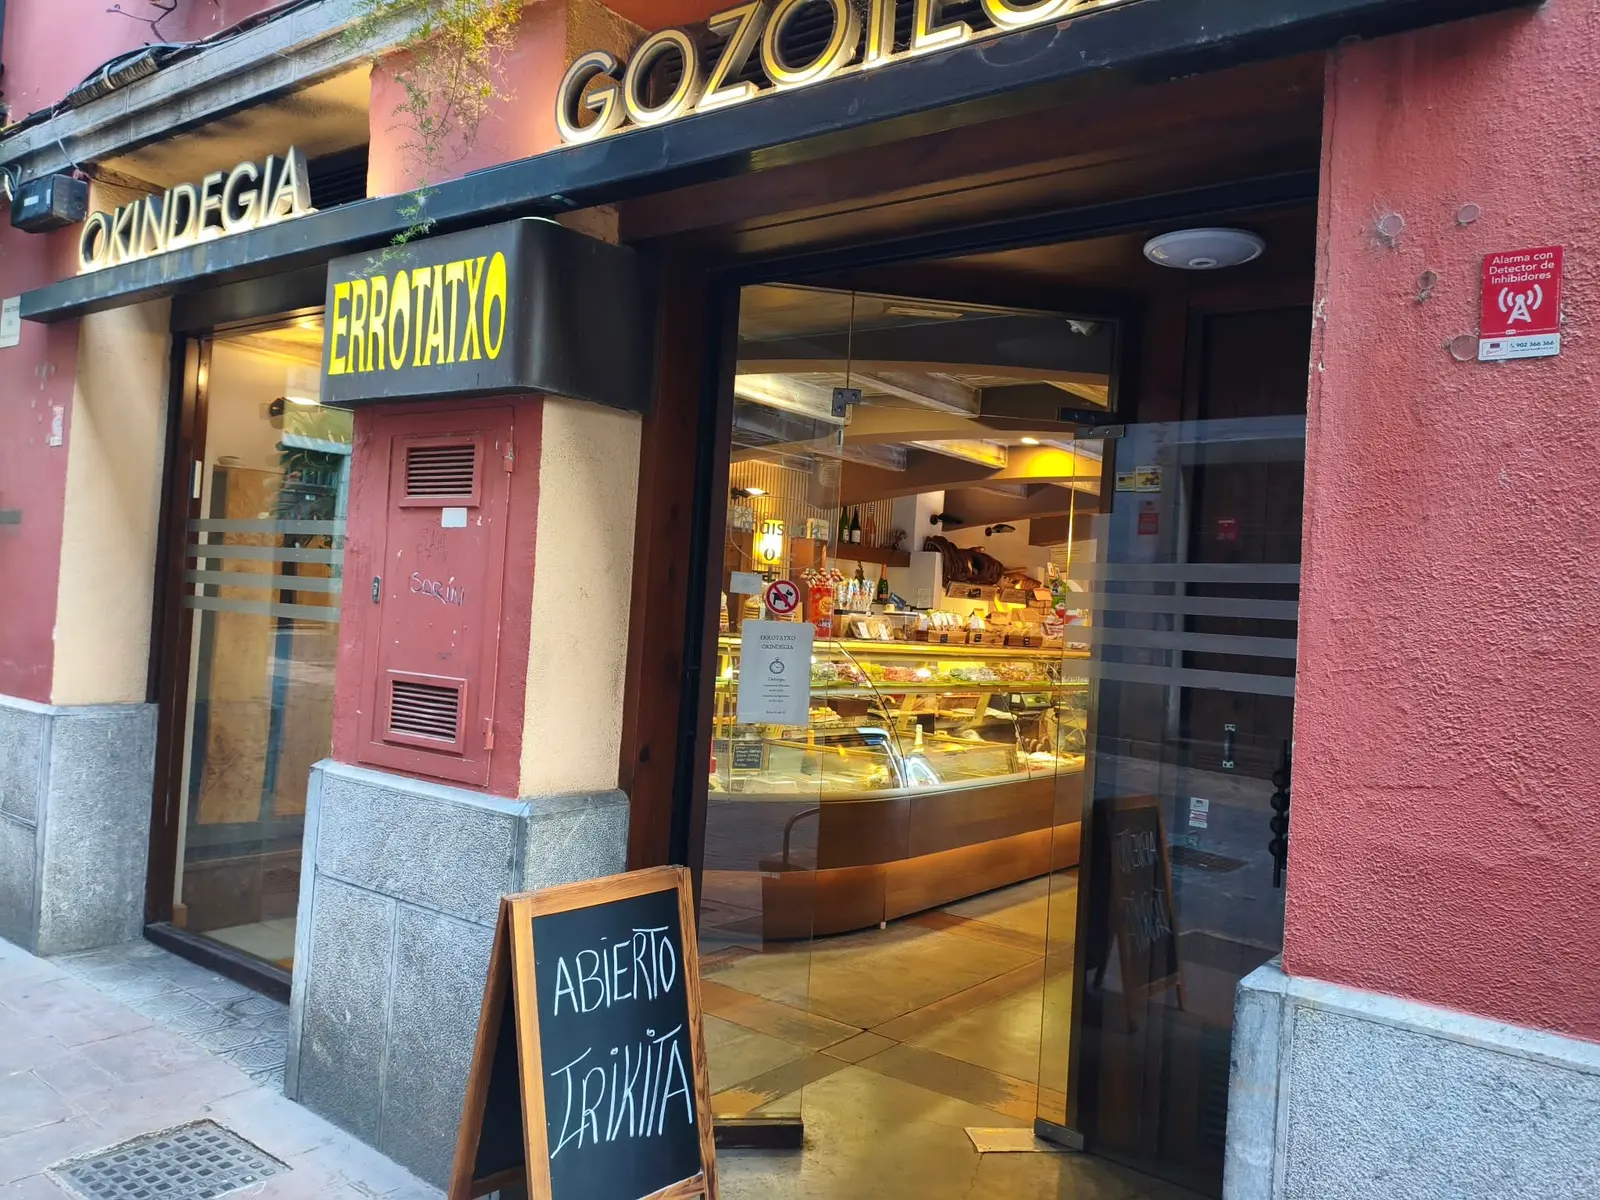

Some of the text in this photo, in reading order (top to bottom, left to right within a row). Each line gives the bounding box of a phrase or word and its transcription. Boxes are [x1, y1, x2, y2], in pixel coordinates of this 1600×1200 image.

[555, 0, 1076, 147] GOZO
[78, 144, 313, 273] OKINDEGIA
[1489, 260, 1555, 275] Detector de
[1491, 271, 1552, 284] Inhibidores
[1492, 252, 1554, 265] Alarma con
[328, 251, 507, 376] ERROTATXO
[554, 926, 677, 1016] ABIERTO
